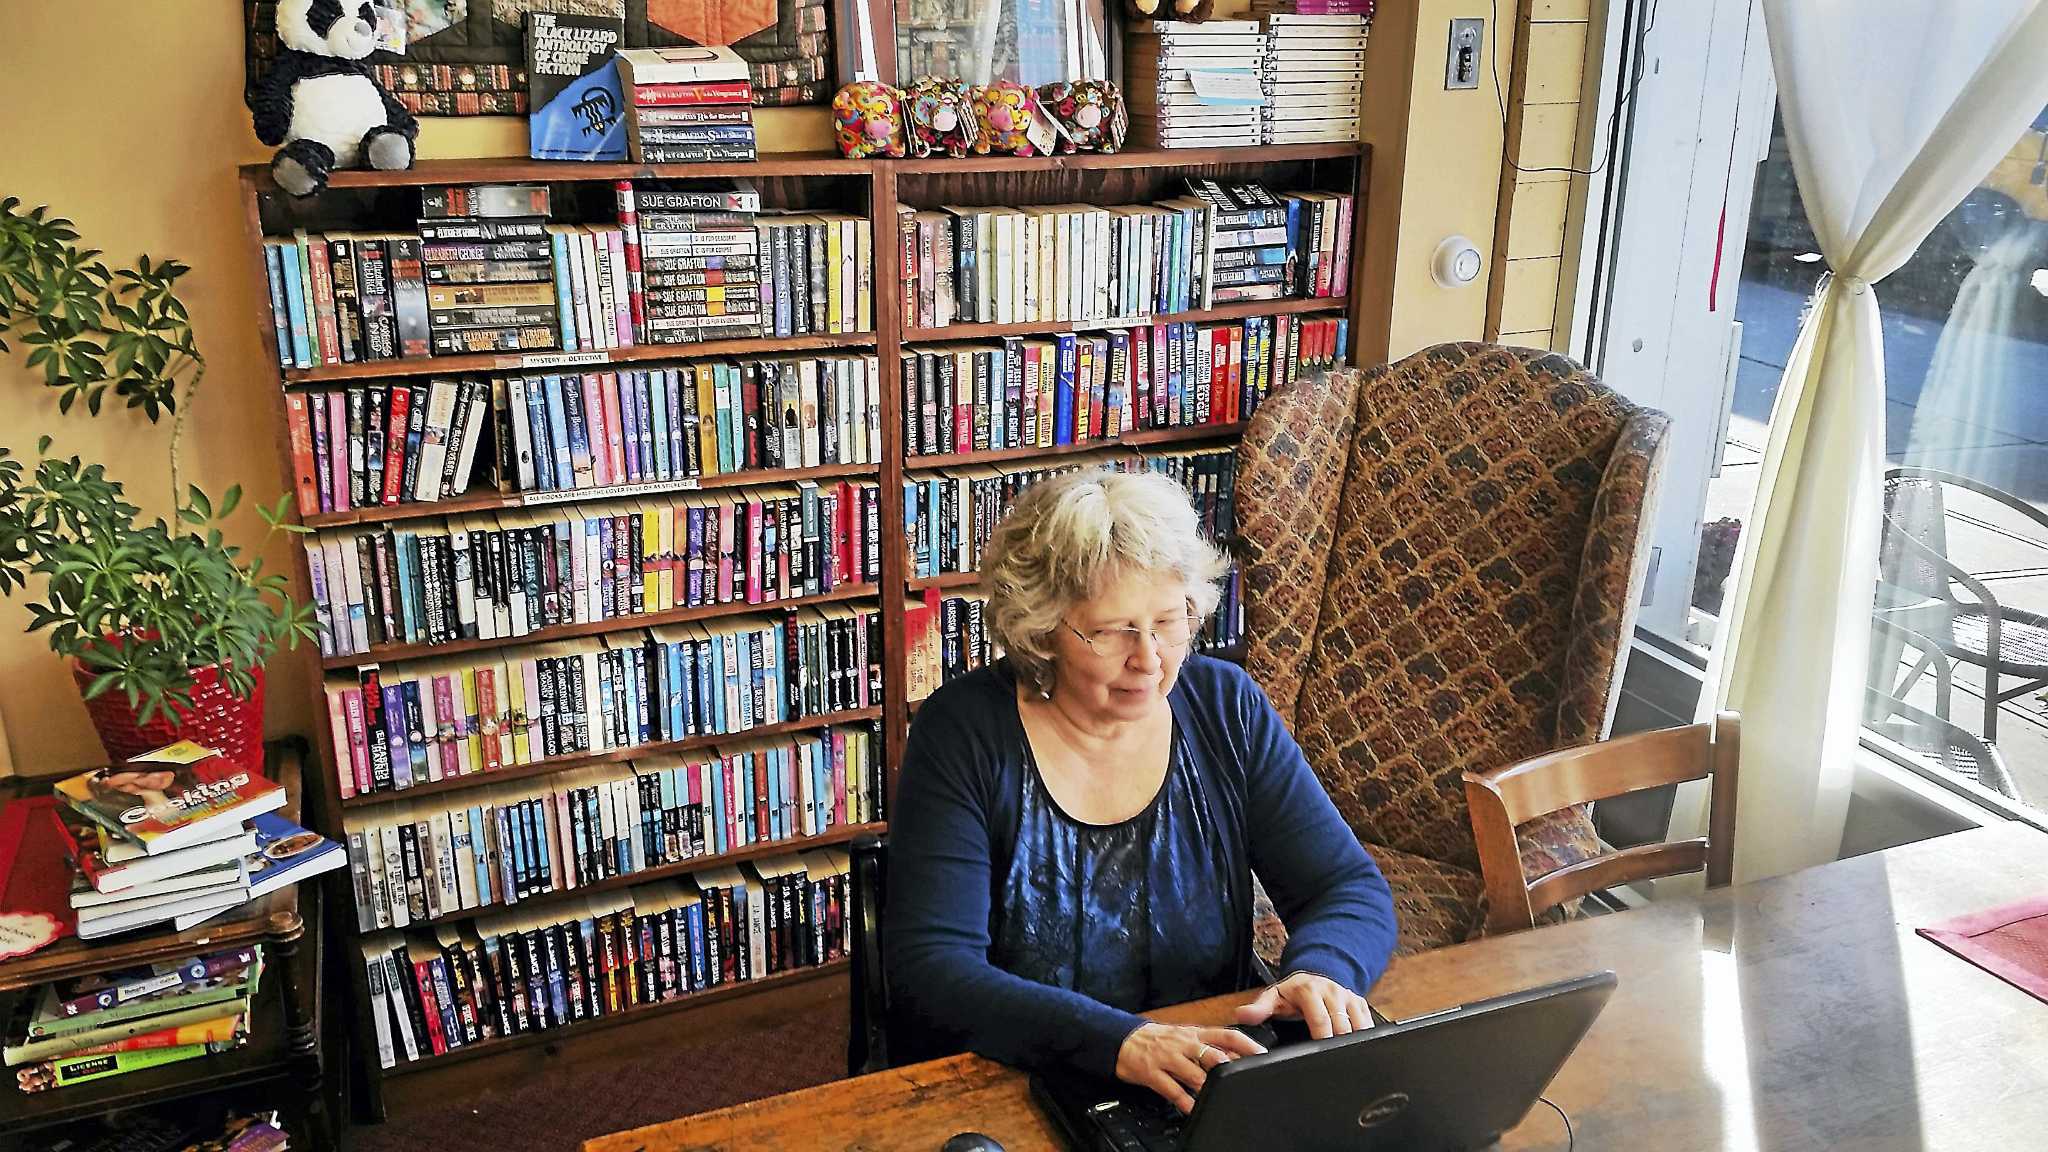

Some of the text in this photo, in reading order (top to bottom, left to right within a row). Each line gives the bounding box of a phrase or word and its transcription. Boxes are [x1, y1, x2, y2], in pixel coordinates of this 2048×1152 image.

[534, 14, 557, 26] THE
[536, 26, 617, 43] BLACK LIZARD
[535, 38, 608, 54] ANTHOLOGY
[536, 50, 589, 65] OF CRIME
[536, 62, 581, 76] FICTION
[640, 193, 721, 208] SUE GRAFTON
[664, 258, 706, 270] SUE GRAFTON
[663, 272, 706, 286] SUE GRAFTON
[663, 288, 706, 302] SUE GRAFTON
[664, 304, 706, 317] SUE GRAFTON
[568, 354, 602, 362] DETECTIVE
[1196, 384, 1205, 418] EDGE
[444, 428, 462, 476] BLOOD VESSEL
[617, 580, 626, 610] HARRIS
[970, 602, 980, 658] CITY SUN
[742, 694, 752, 726] DEADFALL
[372, 744, 382, 780] HAYNES
[376, 730, 390, 780] ELIZABETH
[118, 774, 250, 824] Coking
[69, 1058, 108, 1072] LICENSE
